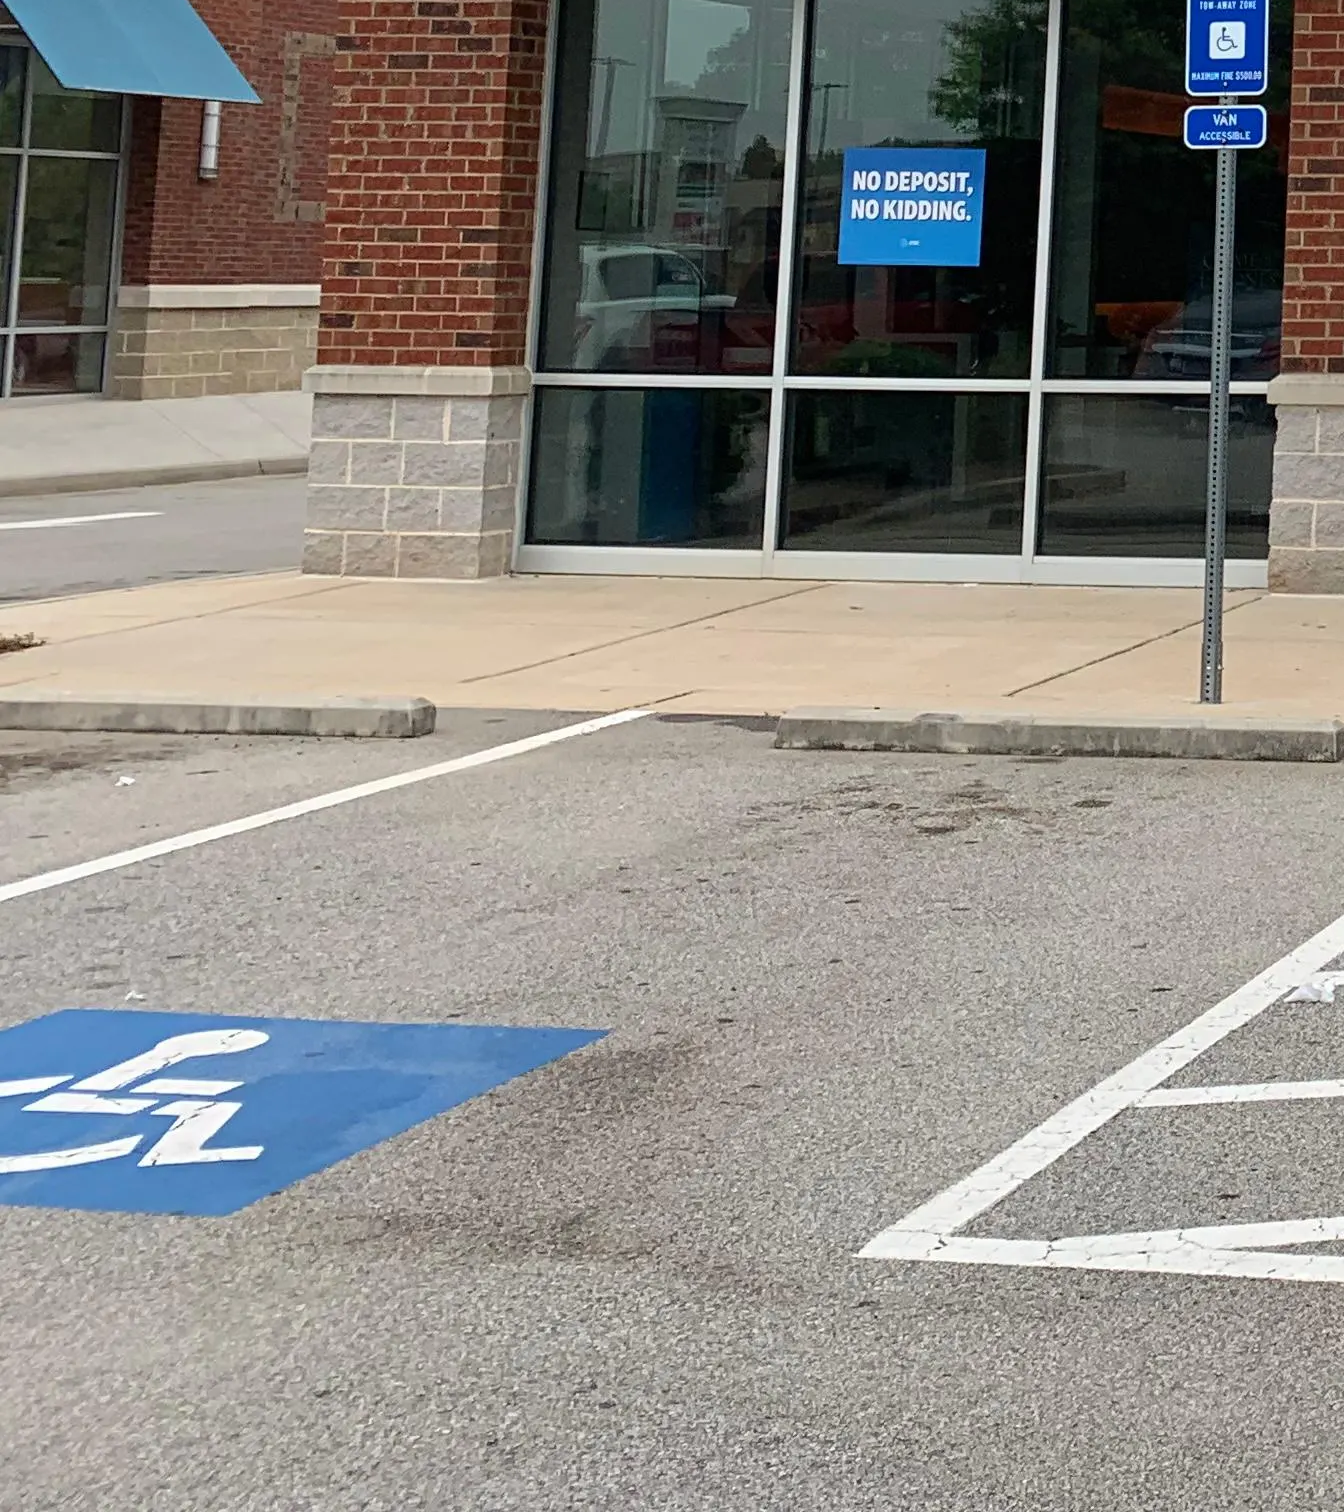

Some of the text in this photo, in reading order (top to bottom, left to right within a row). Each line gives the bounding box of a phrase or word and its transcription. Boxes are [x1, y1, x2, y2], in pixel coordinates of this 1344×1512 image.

[1199, 0, 1257, 10] TOW-AWAY ZONE
[1191, 71, 1220, 81] MAXIMUM
[1221, 71, 1235, 81] FINE
[1212, 113, 1237, 126] VAN
[1199, 130, 1251, 141] ACCESSIBLE
[852, 170, 974, 197] NO DEPOSIT,
[851, 199, 972, 222] NO KIDDING.
